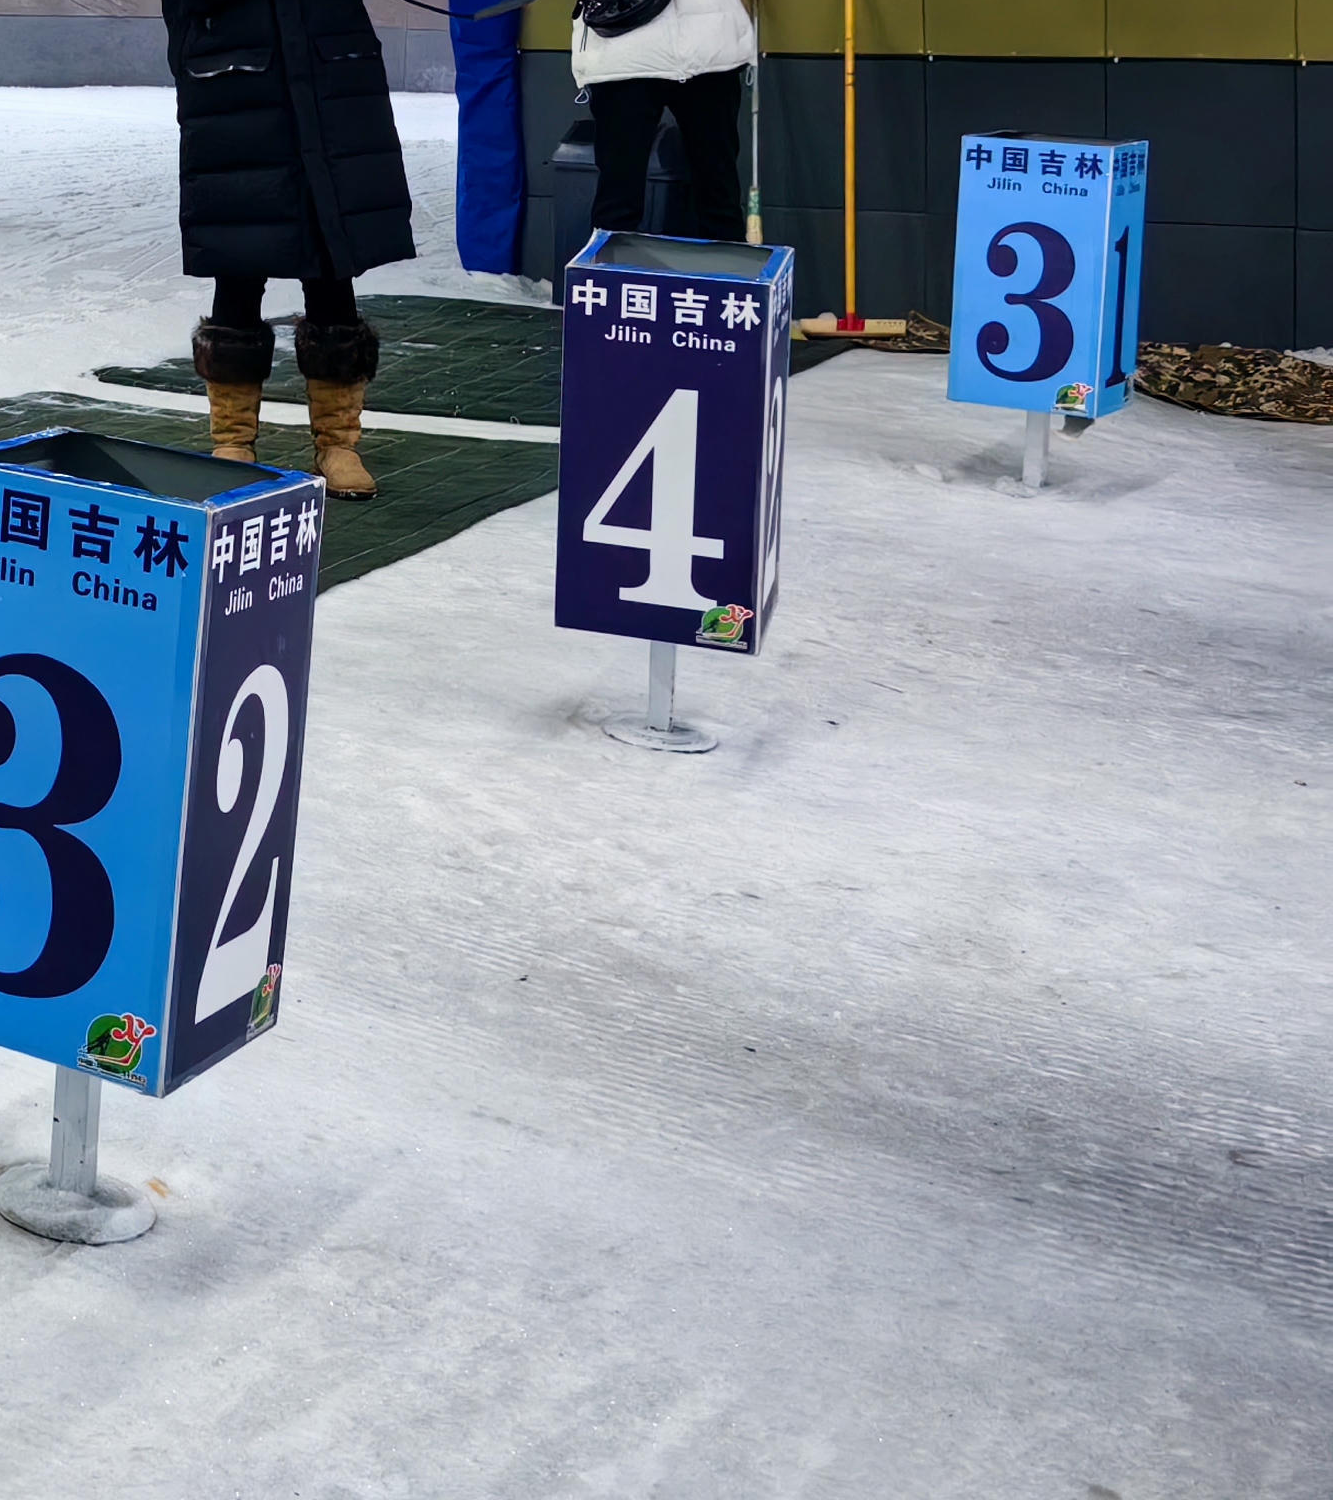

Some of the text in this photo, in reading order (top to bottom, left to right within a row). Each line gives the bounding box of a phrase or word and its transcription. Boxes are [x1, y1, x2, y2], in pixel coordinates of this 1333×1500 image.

[966, 143, 1104, 180] 中国吉林
[987, 177, 1088, 197] Jilin China
[571, 279, 762, 331] 中国吉林
[977, 221, 1076, 382] 3
[1105, 226, 1130, 388] 1
[605, 325, 736, 352] Jilin China
[583, 388, 724, 612] 4
[211, 498, 318, 584] 中国吉林
[72, 571, 157, 611] China
[225, 572, 304, 616] Jilin China
[194, 664, 290, 1024] 2
